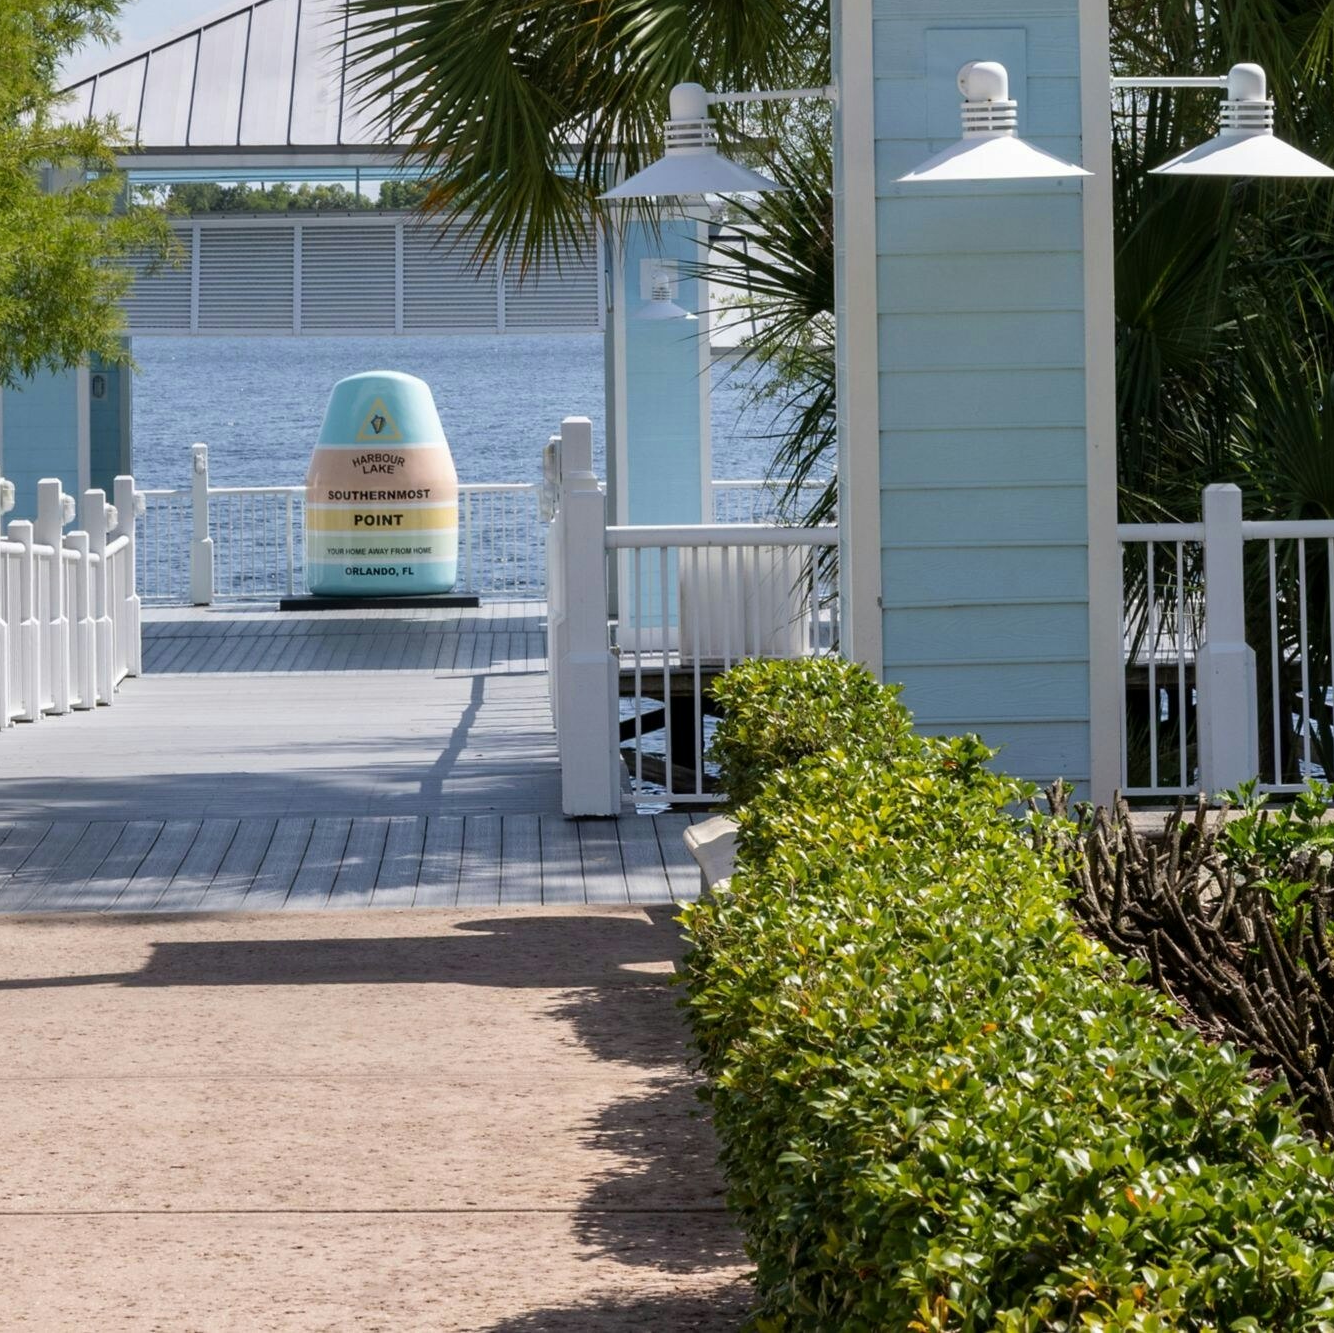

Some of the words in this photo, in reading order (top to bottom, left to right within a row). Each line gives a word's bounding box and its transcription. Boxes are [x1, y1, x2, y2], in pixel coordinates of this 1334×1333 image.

[352, 453, 405, 467] HARBOUR
[363, 464, 395, 474] LAKE
[328, 489, 430, 500] SOUTHERNMOST
[354, 514, 403, 526] POINT
[345, 567, 399, 577] ORLANDO,
[402, 567, 414, 575] FL
